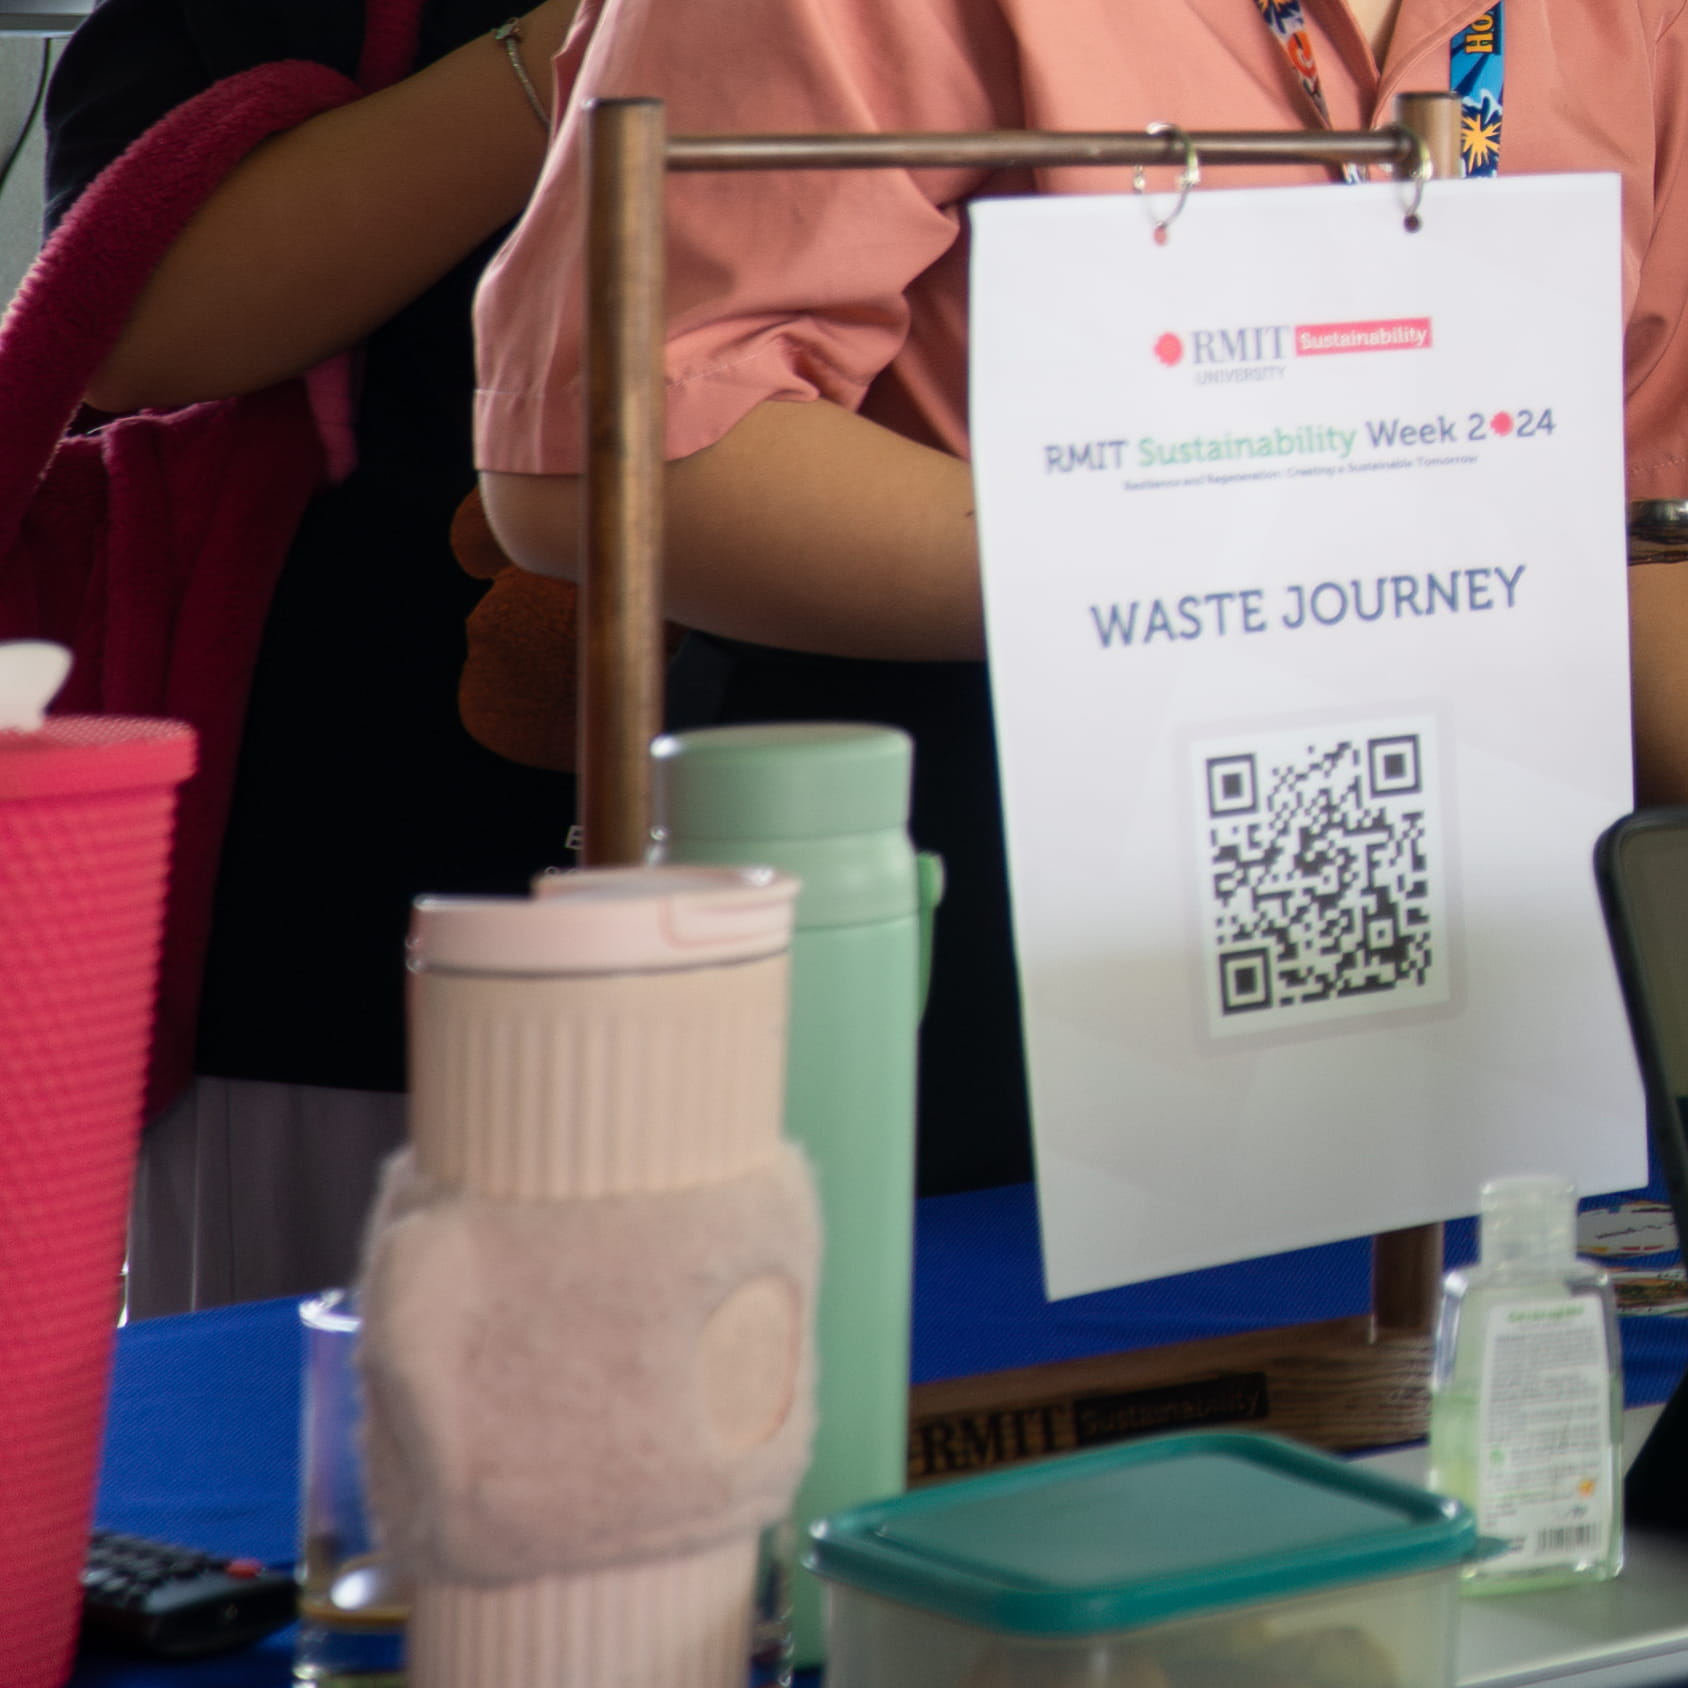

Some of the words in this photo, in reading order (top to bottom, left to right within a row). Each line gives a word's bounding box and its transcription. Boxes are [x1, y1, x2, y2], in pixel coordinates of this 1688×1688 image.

[1192, 325, 1290, 365] RMIT
[1300, 326, 1428, 350] Sustainability
[1196, 365, 1287, 386] UNIVERSITY
[1044, 438, 1128, 474] RMIT
[1137, 424, 1358, 467] Sustainability
[1366, 415, 1458, 449] Week
[1090, 588, 1267, 649] WASTE
[1282, 563, 1526, 630] JOURNEY
[918, 1404, 1066, 1473] RMIT
[1080, 1386, 1261, 1436] Sustainability
